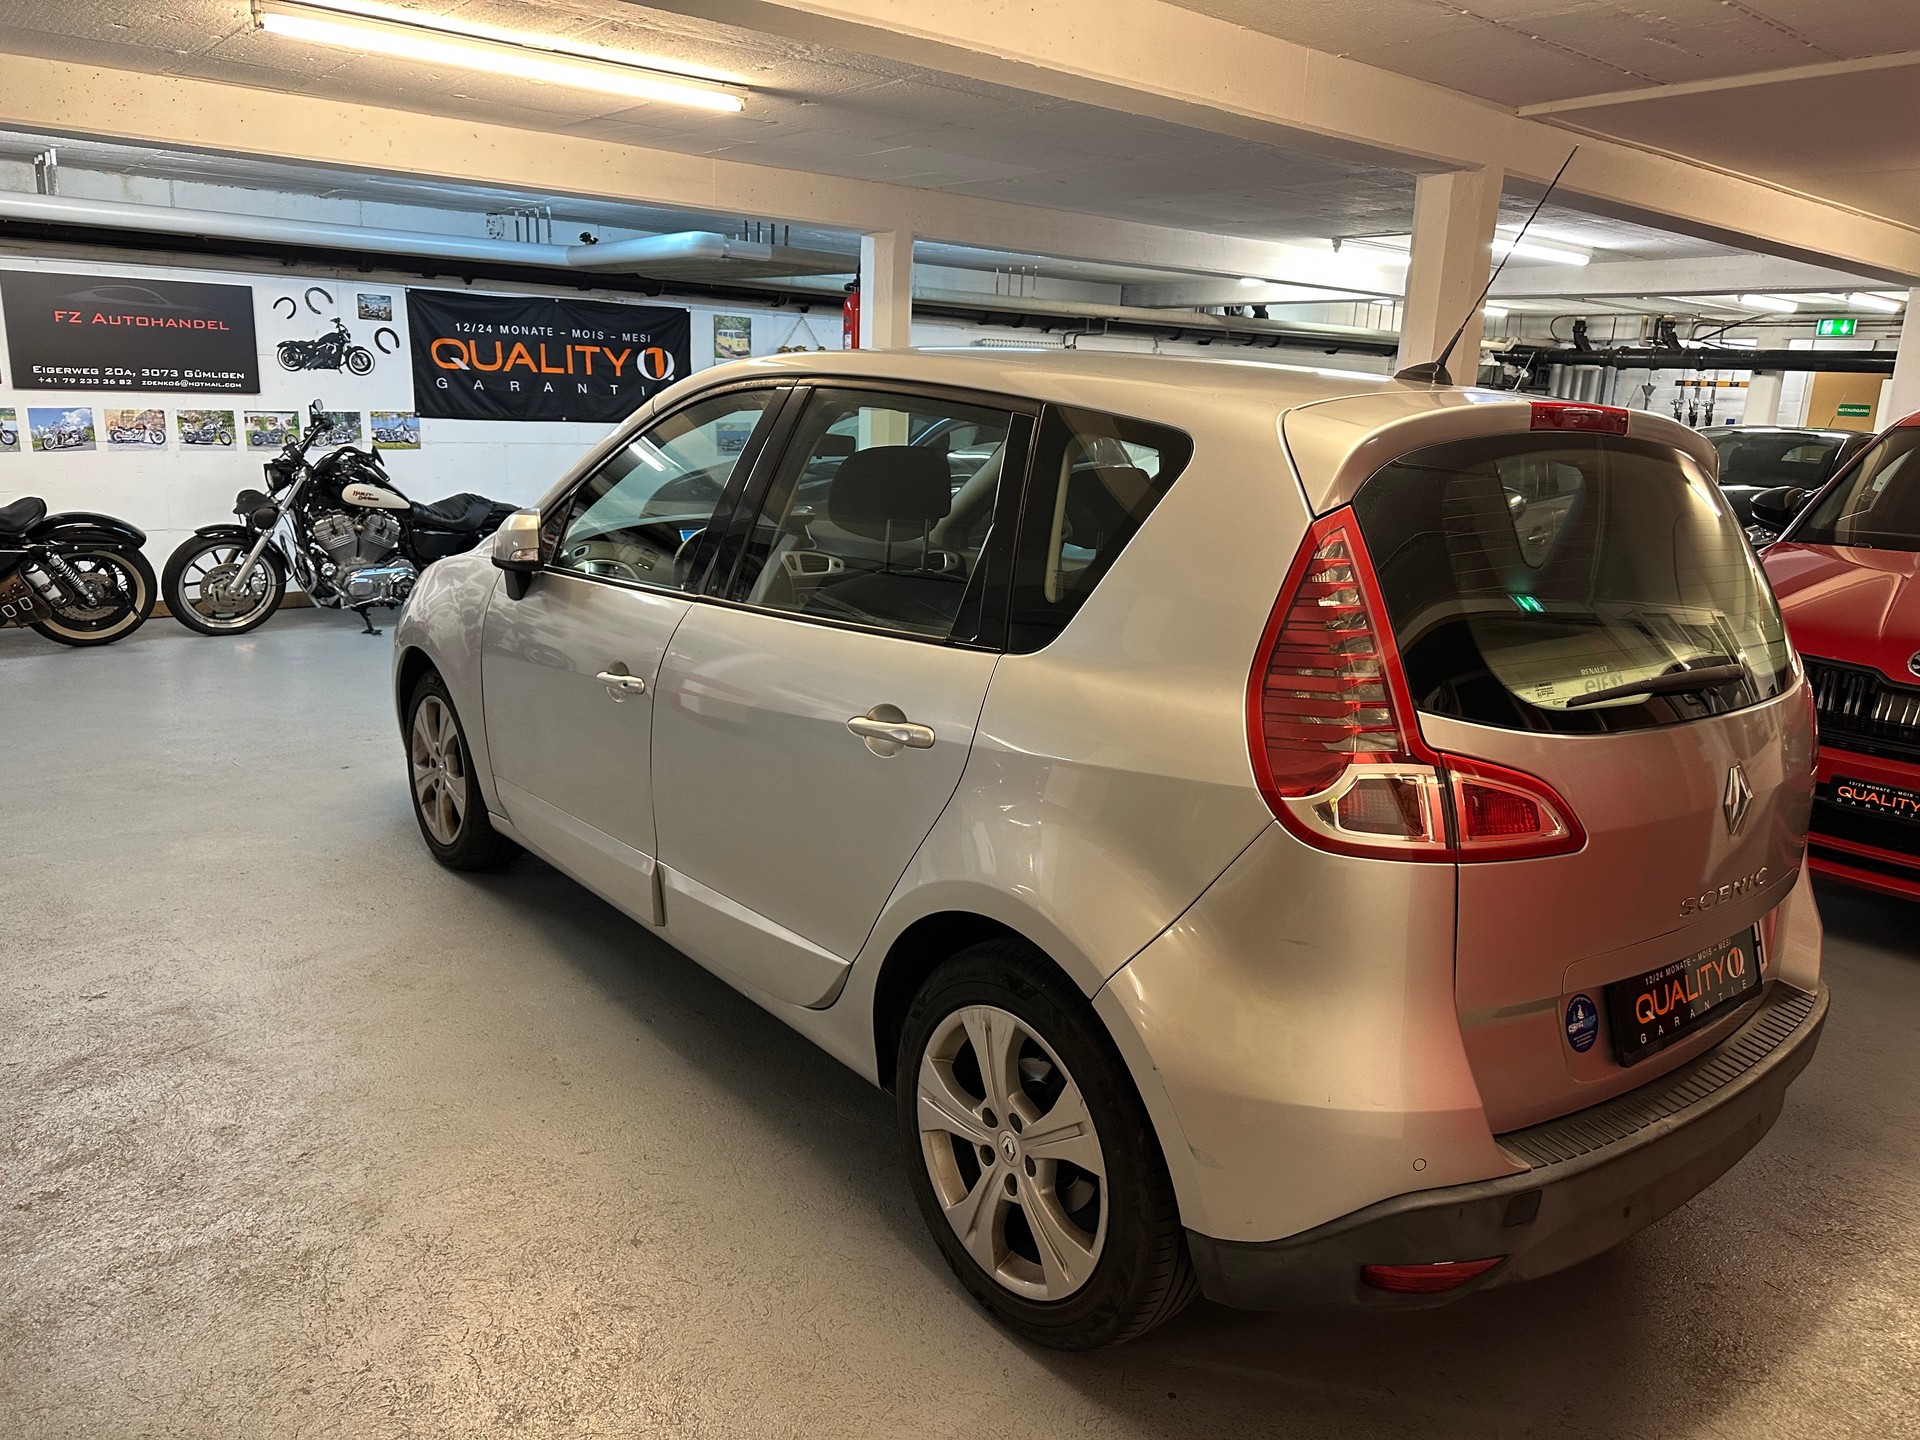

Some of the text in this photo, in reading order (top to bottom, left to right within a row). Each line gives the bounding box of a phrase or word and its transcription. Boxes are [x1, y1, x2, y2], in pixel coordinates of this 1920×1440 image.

[54, 310, 230, 331] FZ AUTOHANDEL
[455, 322, 493, 333] 12/24
[499, 325, 554, 337] MONATE
[571, 328, 604, 340] MOIS
[622, 333, 651, 343] MESI
[32, 365, 99, 375] EIGERWEG
[141, 368, 179, 377] 3073
[184, 369, 245, 379] GÜMLIGEN
[38, 376, 58, 384] +41
[436, 377, 646, 397] GARANTI
[1580, 665, 1609, 676] RENAULT
[1836, 797, 1915, 818] GARANT
[1837, 786, 1920, 812] QUALITY
[1678, 866, 1768, 919] SCENIC
[1645, 970, 1664, 986] 12/24
[1665, 957, 1691, 976] MONATE
[1697, 947, 1713, 961] MOIS
[1718, 937, 1732, 951] MESI
[1640, 979, 1747, 1044] GARANTIE
